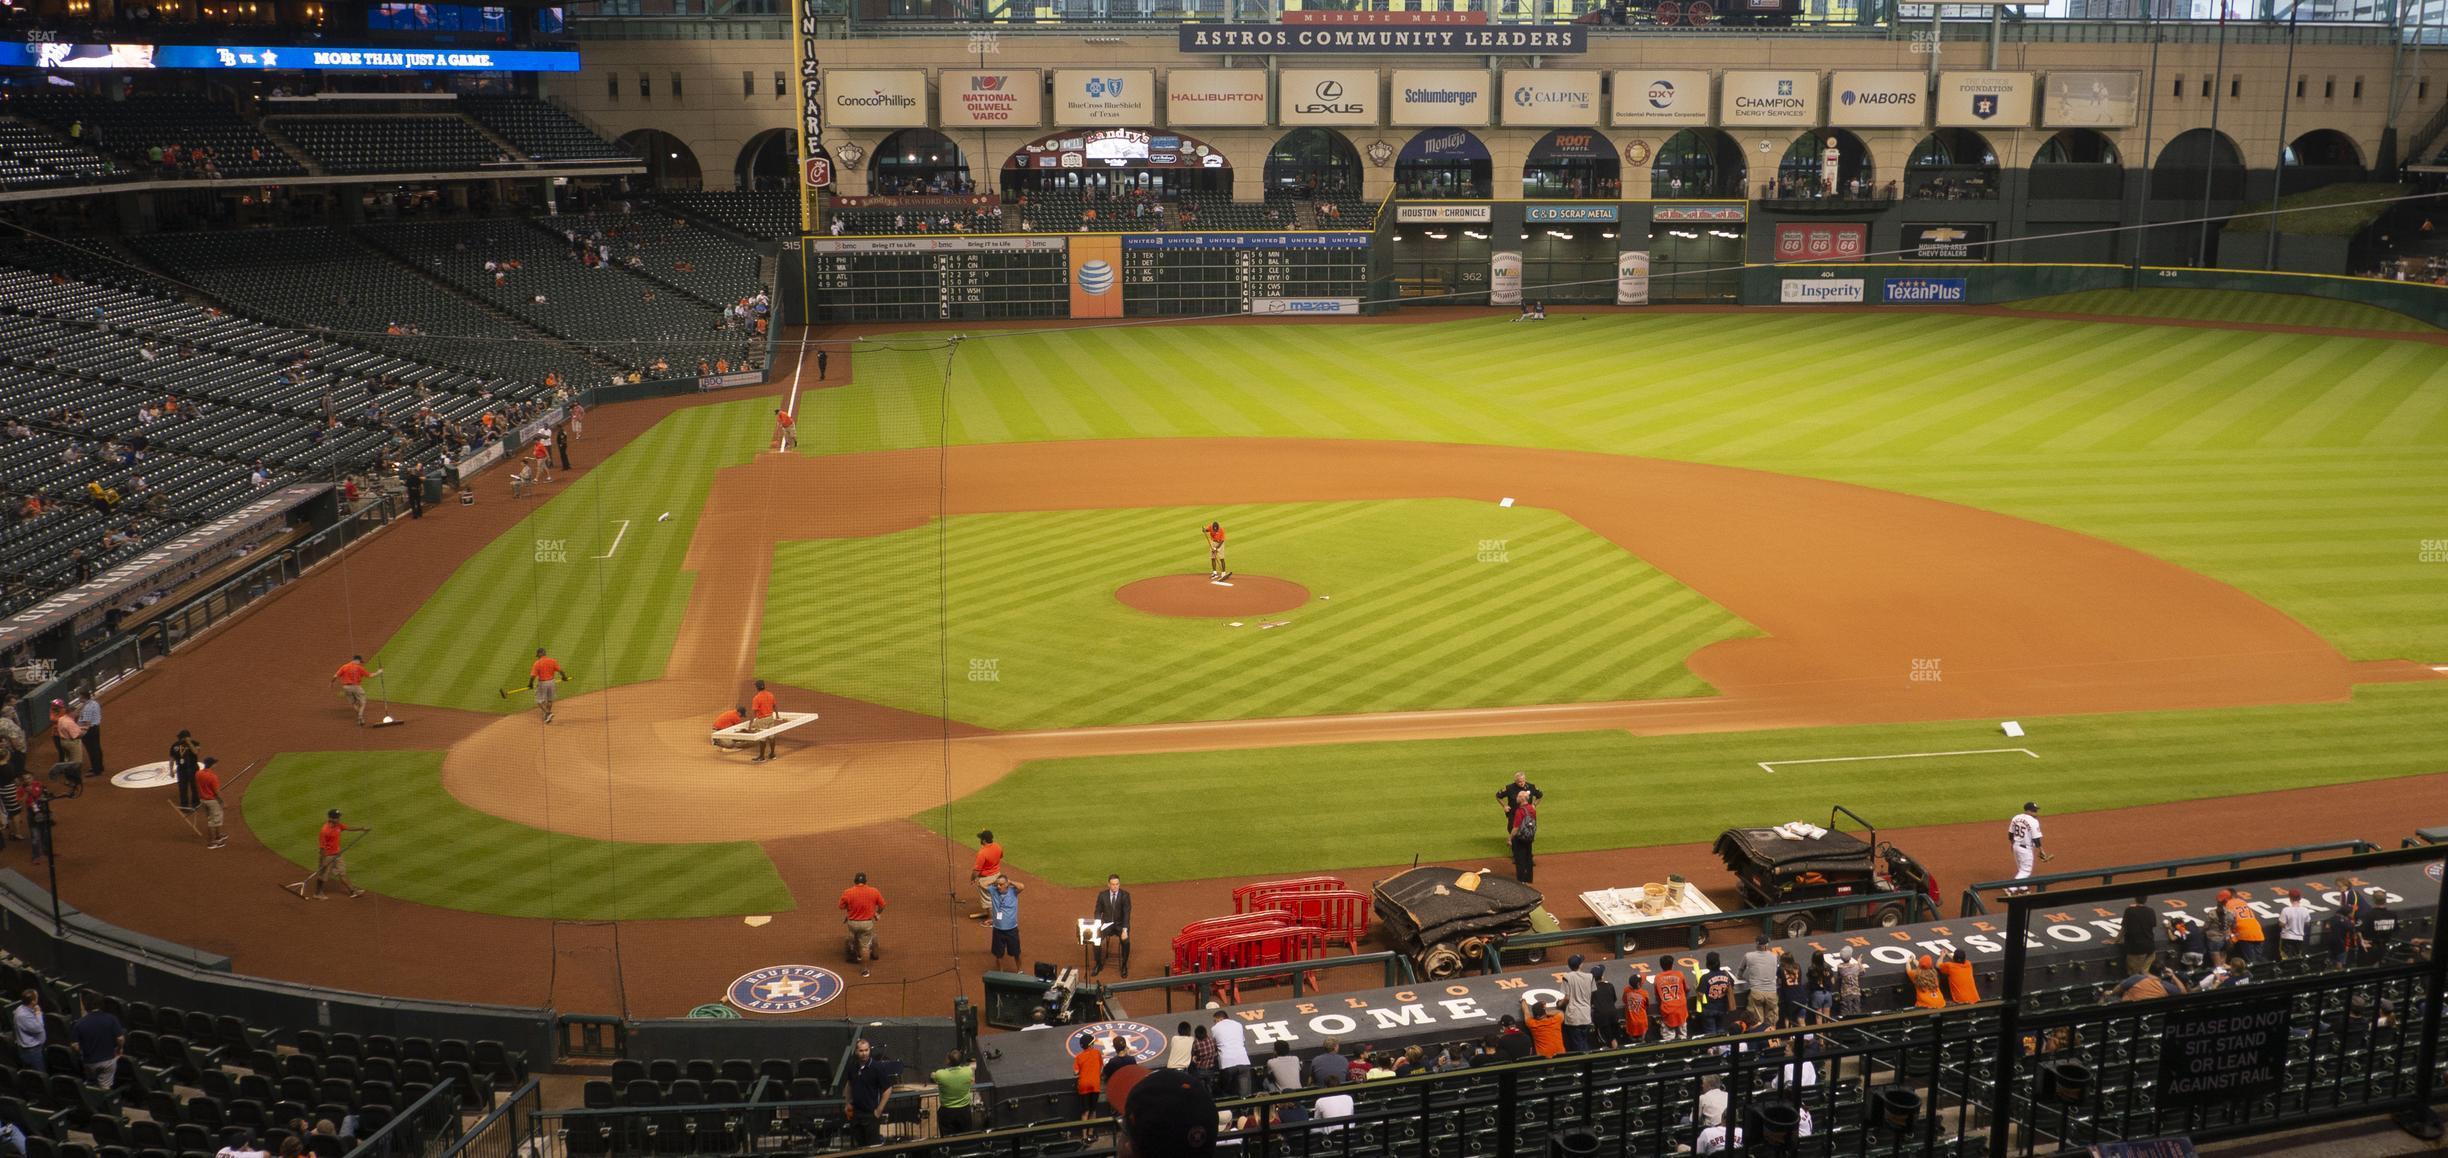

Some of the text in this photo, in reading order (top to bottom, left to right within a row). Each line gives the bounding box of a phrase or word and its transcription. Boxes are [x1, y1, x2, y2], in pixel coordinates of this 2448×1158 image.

[1305, 14, 1467, 22] MINUTE MAID
[1196, 31, 1572, 46] ASTROS COMMUNITY LEADERS
[314, 52, 494, 68] MORE THAN JUST A GAME.
[837, 95, 916, 108] ConocoPhillips
[1172, 93, 1263, 102] HALLIBURTON
[1405, 88, 1477, 105] Schlumberger
[1535, 92, 1589, 102] CALPINE
[1736, 97, 1804, 108] CHAMPION
[1859, 93, 1916, 104] NABORS
[1295, 104, 1364, 114] LEXUS
[1556, 134, 1592, 146] ROOT
[1402, 208, 1486, 217] HOUSTON CHRONICLE
[1532, 209, 1539, 218] C
[1549, 209, 1557, 218] D
[1560, 209, 1586, 218] SCRAP
[1587, 209, 1612, 218] METAL
[1784, 240, 1799, 250] 66
[1812, 240, 1827, 250] 66
[1840, 240, 1855, 250] 66
[1801, 284, 1861, 299] Insperity
[1888, 284, 1960, 299] TexanPlus
[1290, 302, 1340, 311] mazda
[2014, 824, 2026, 838] 85
[2044, 900, 2188, 924] MAD
[1245, 997, 1488, 1046] HOME
[2162, 886, 2404, 928] ATROS
[746, 968, 826, 984] HOUSTON
[1661, 985, 1680, 1001] 27
[748, 996, 822, 1009] ASTROS
[2166, 1010, 2287, 1038] PLEASE DO NOT
[2216, 1032, 2266, 1051] STAND
[2190, 1052, 2258, 1073] OR LEAN
[2168, 1066, 2273, 1094] AGAINST RAIL
